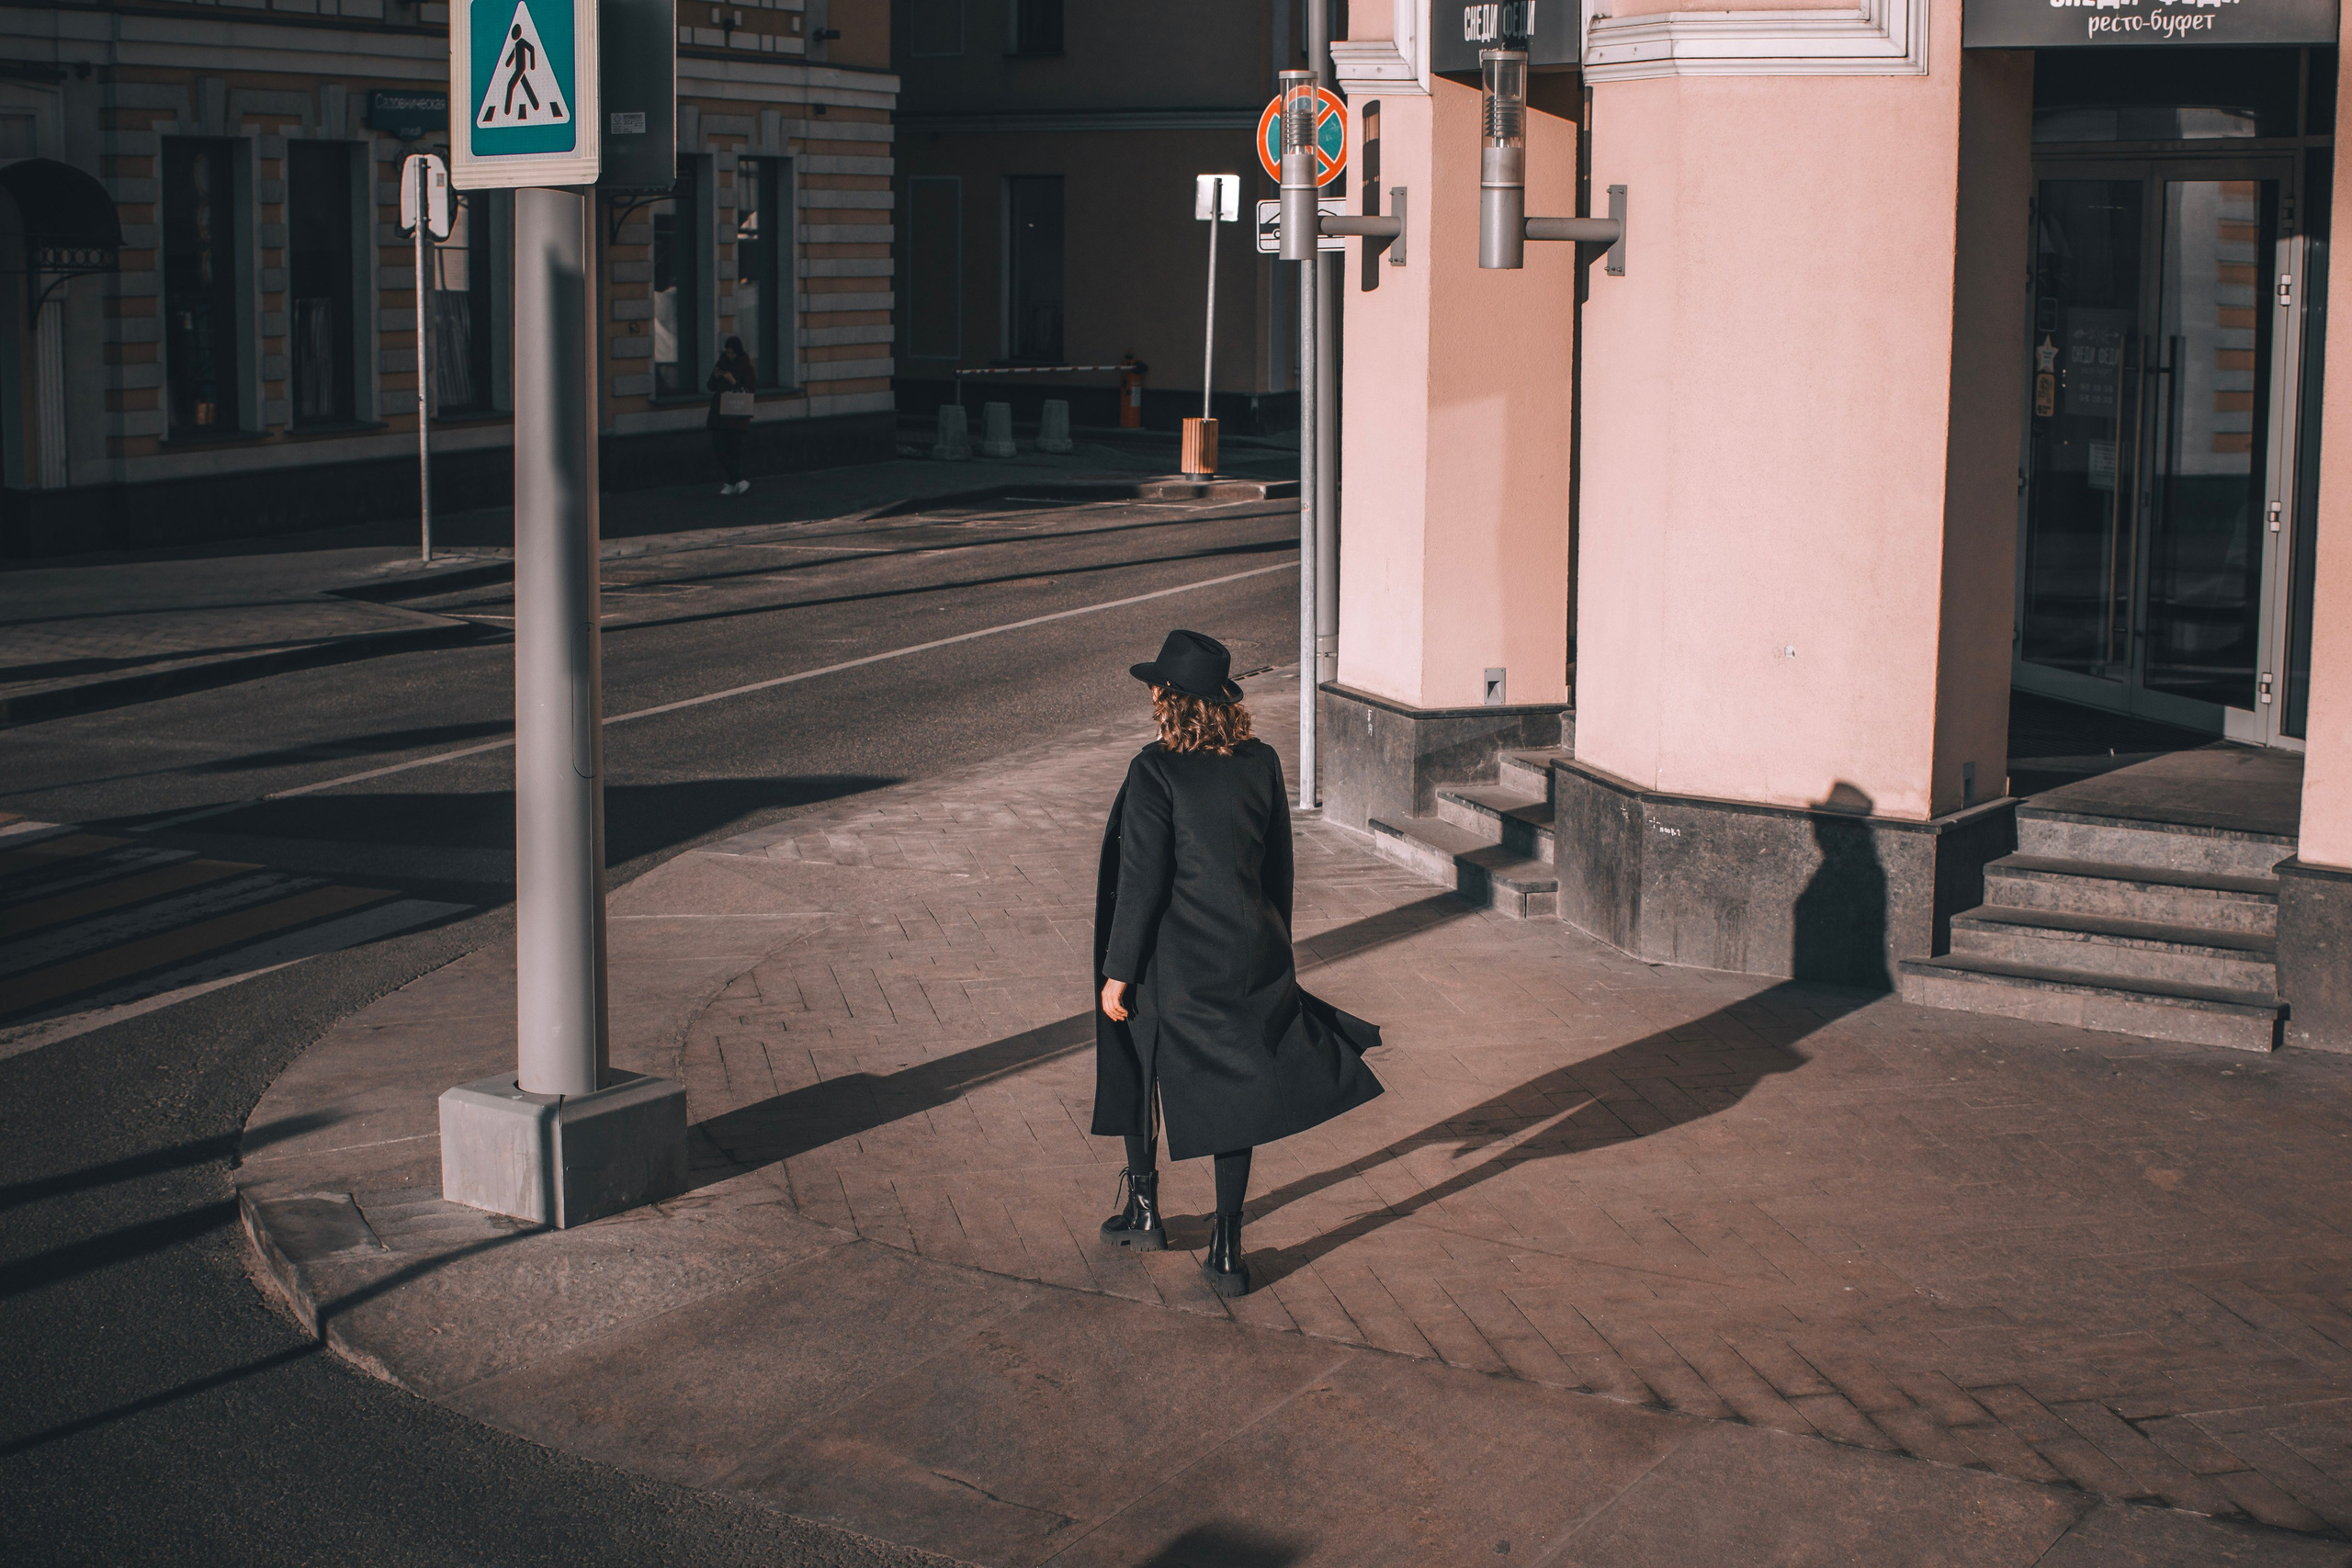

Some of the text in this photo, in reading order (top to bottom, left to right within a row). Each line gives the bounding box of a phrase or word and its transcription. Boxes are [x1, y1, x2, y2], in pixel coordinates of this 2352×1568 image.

[1464, 0, 1535, 42] СНЕДИ ФЕДИ
[2088, 8, 2215, 39] ресто-буфет
[375, 93, 446, 110] Садовническая
